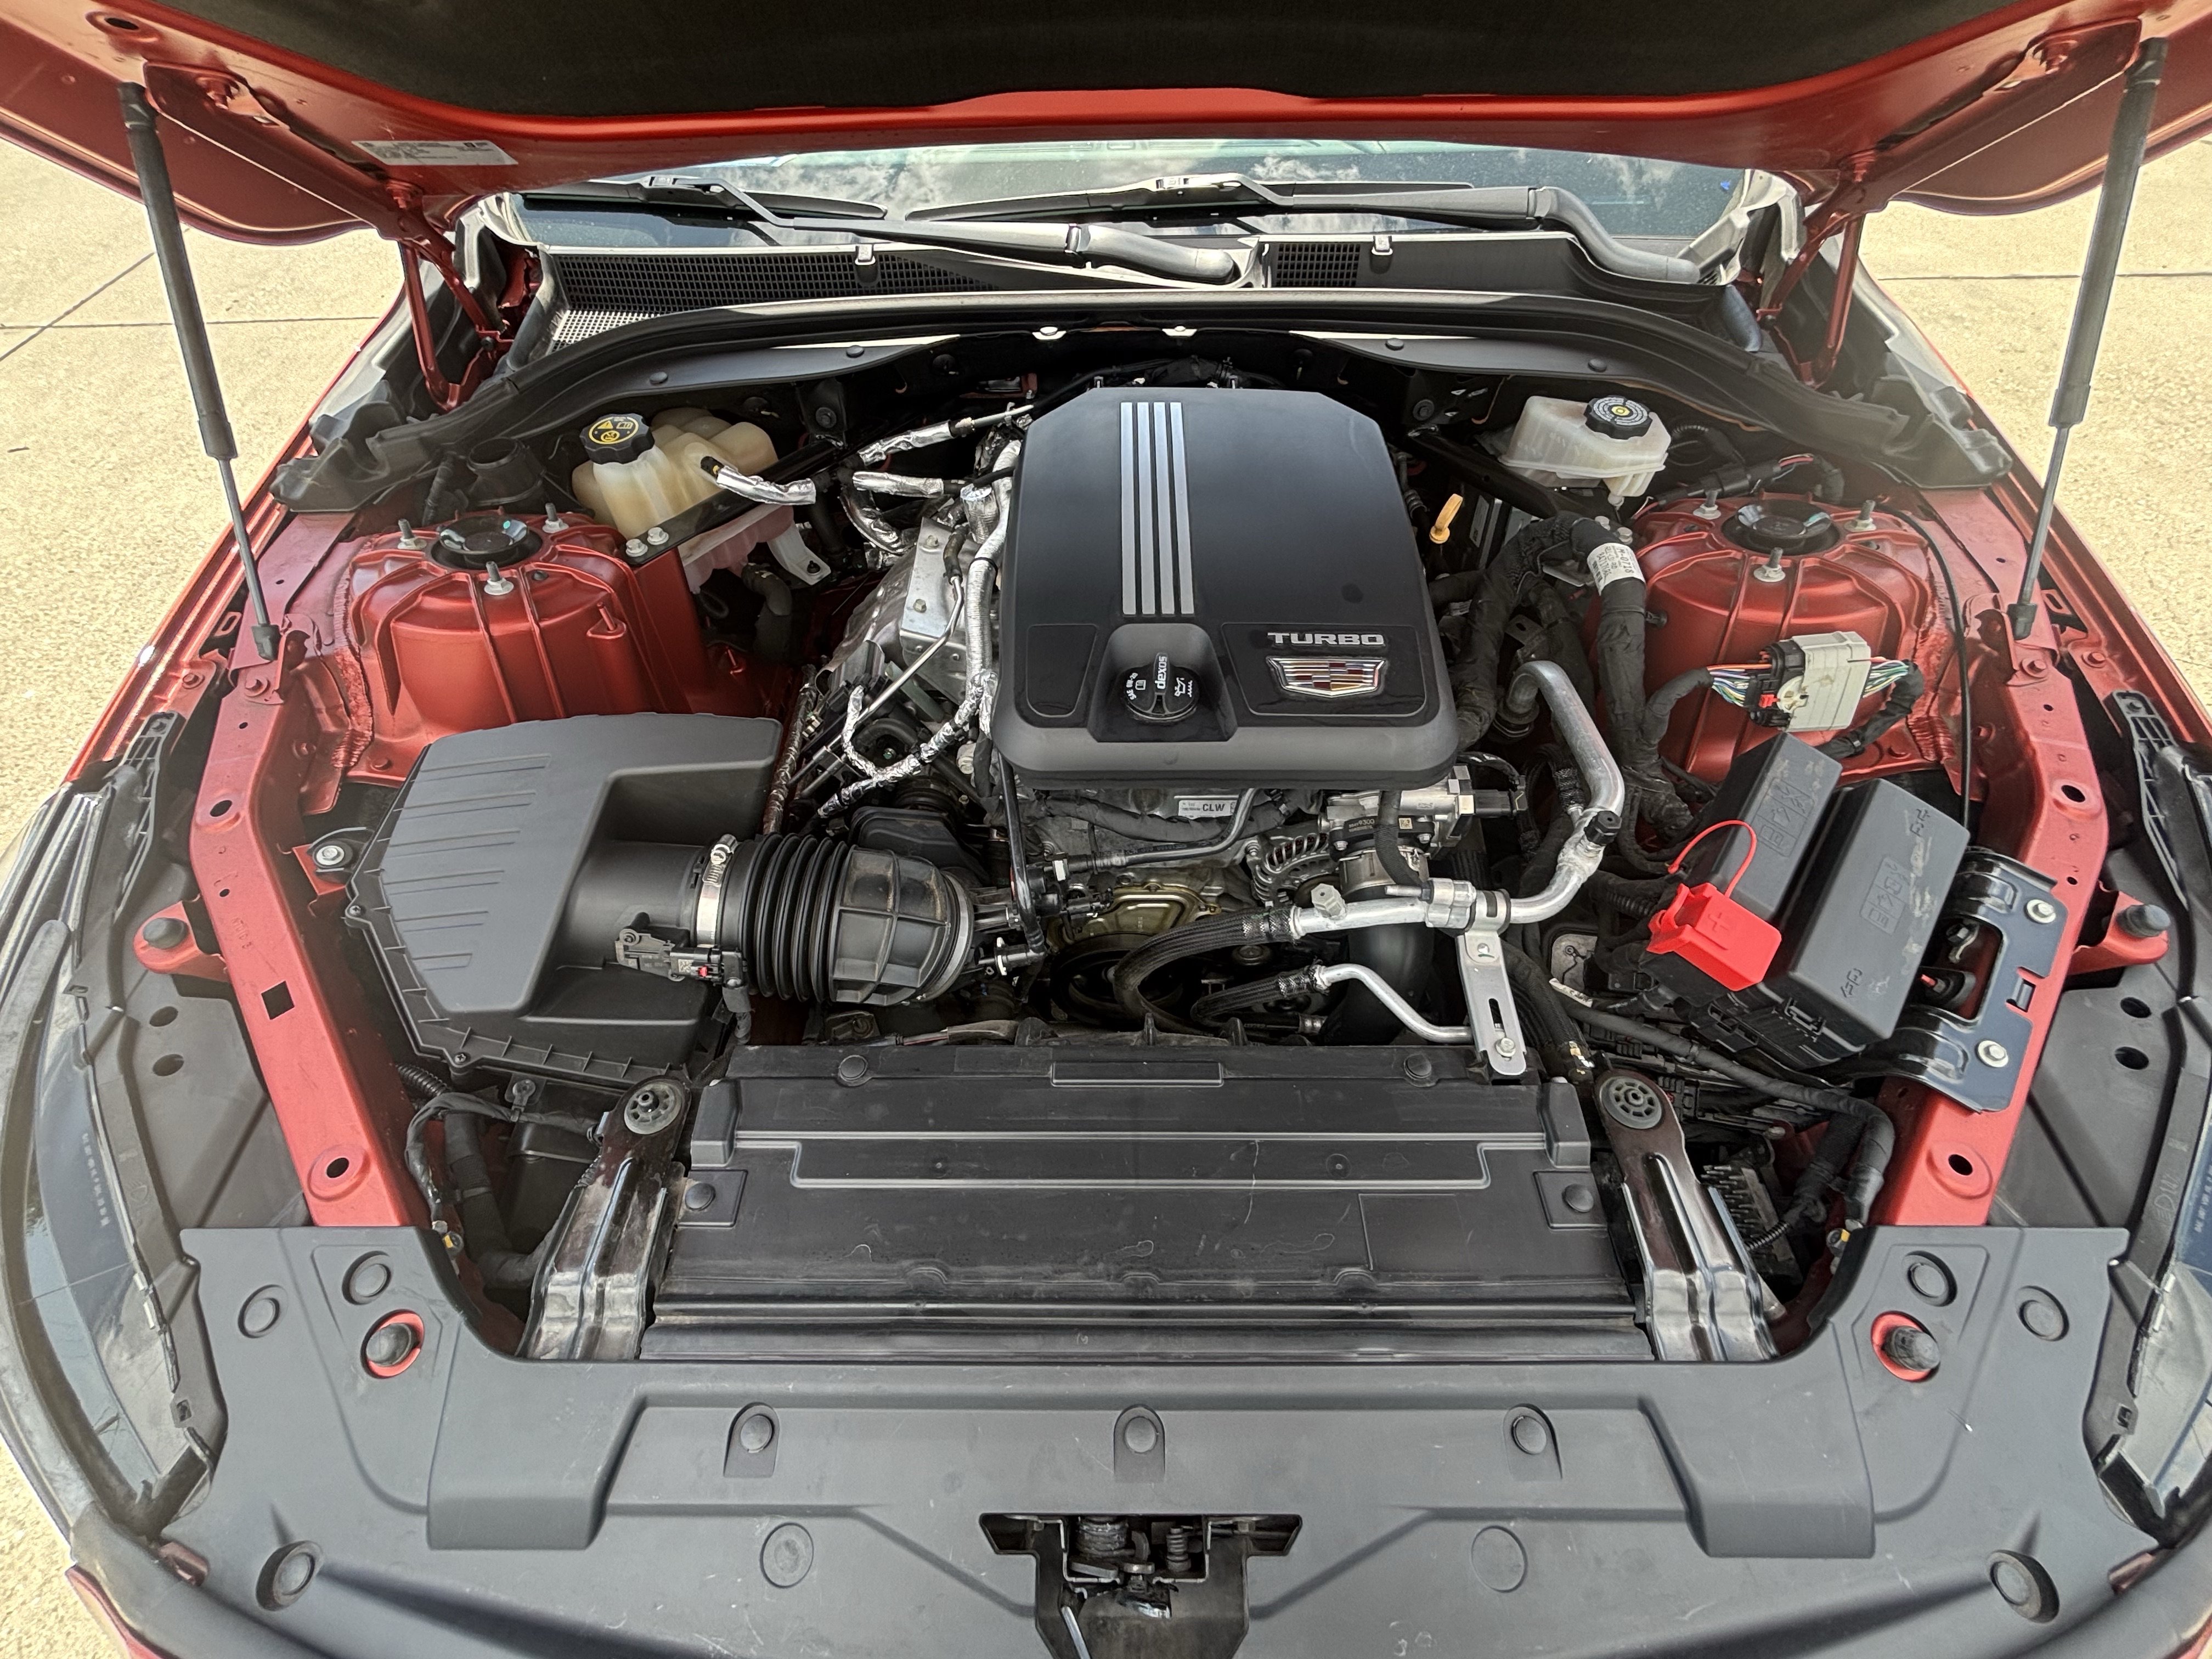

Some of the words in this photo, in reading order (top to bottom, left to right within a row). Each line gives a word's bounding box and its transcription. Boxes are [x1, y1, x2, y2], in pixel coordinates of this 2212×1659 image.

[1267, 633, 1385, 645] TURBO
[1154, 656, 1167, 690] dexos
[1126, 689, 1137, 700] SAE
[1202, 803, 1225, 812] CLW
